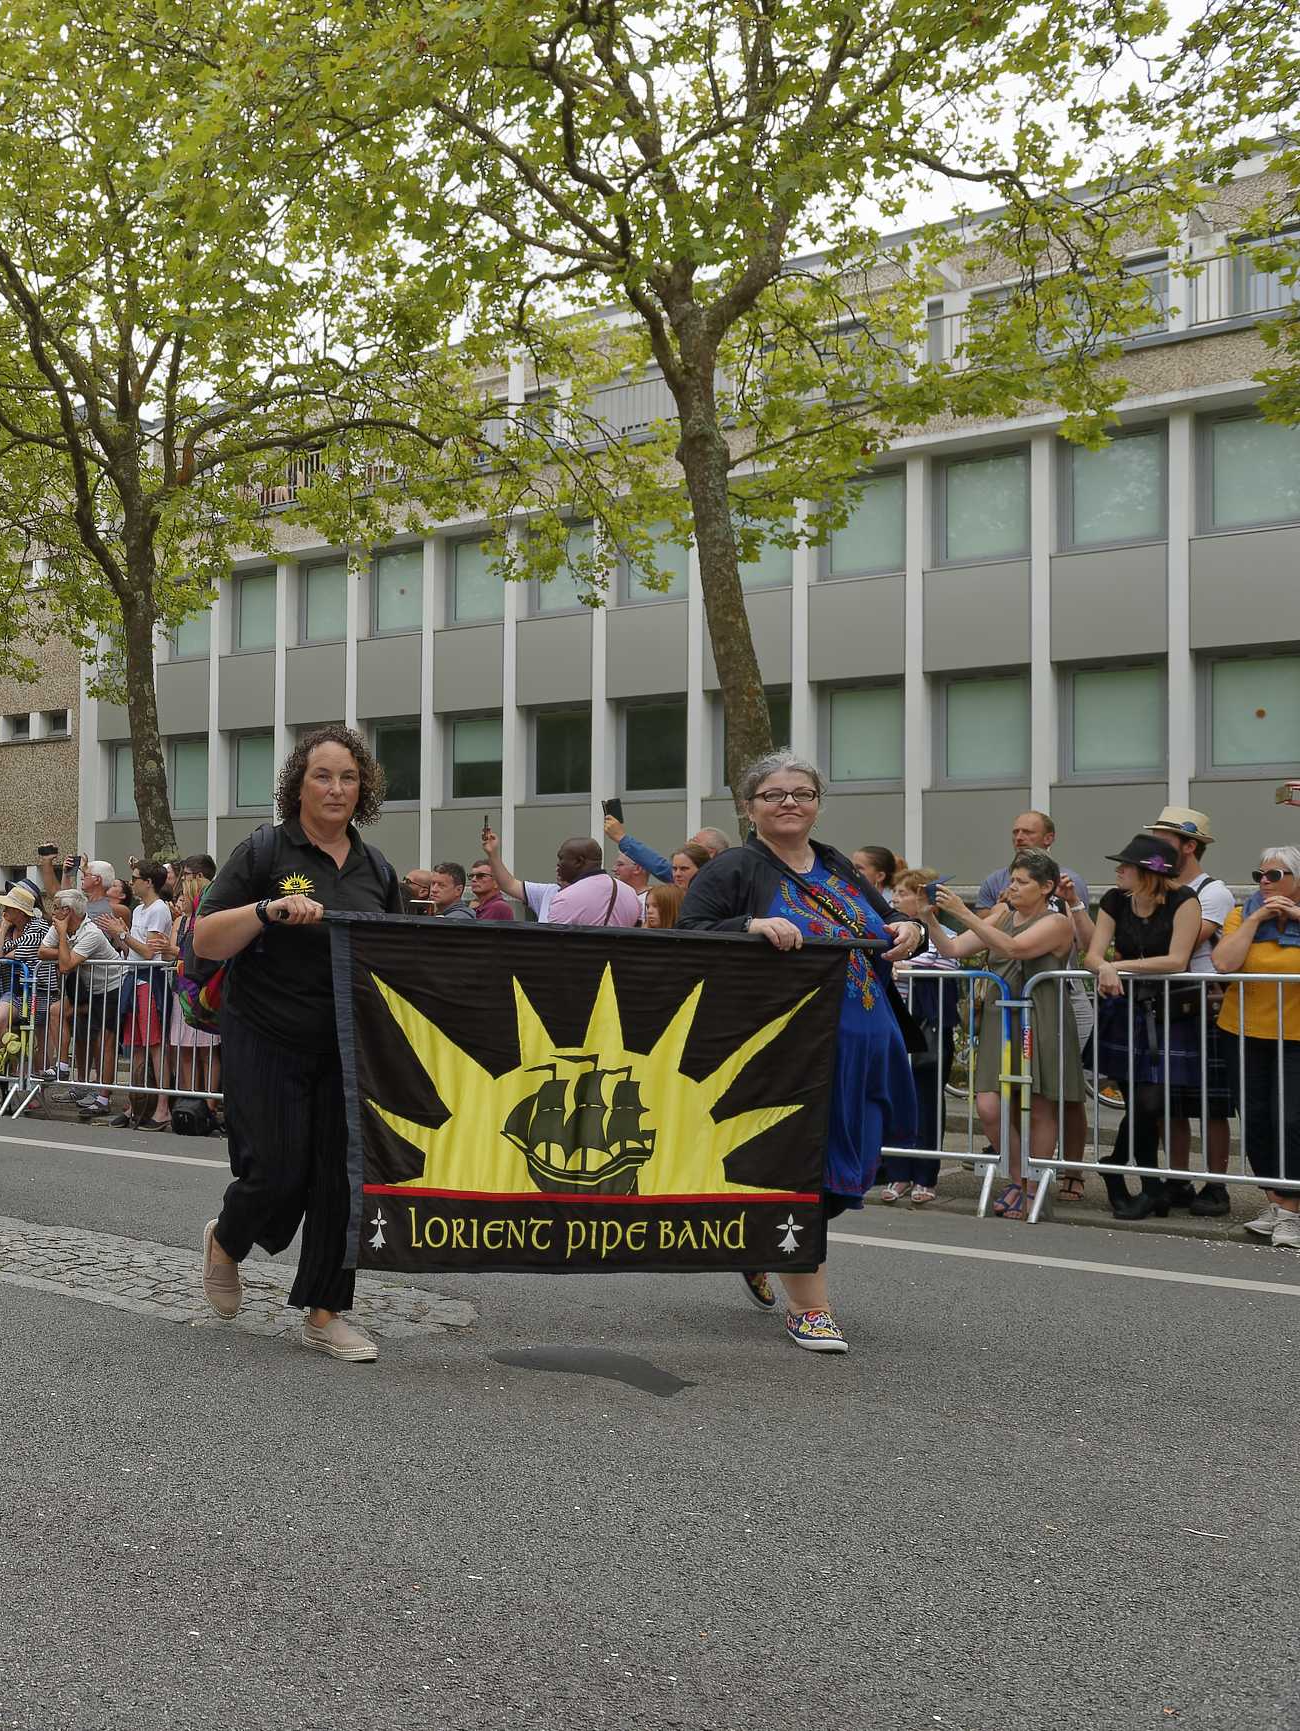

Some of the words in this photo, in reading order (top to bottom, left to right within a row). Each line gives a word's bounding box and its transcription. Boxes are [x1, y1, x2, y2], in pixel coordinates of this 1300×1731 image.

[408, 1207, 554, 1250] LORIENT
[566, 1220, 649, 1259] PIPE
[658, 1211, 747, 1249] BAND
